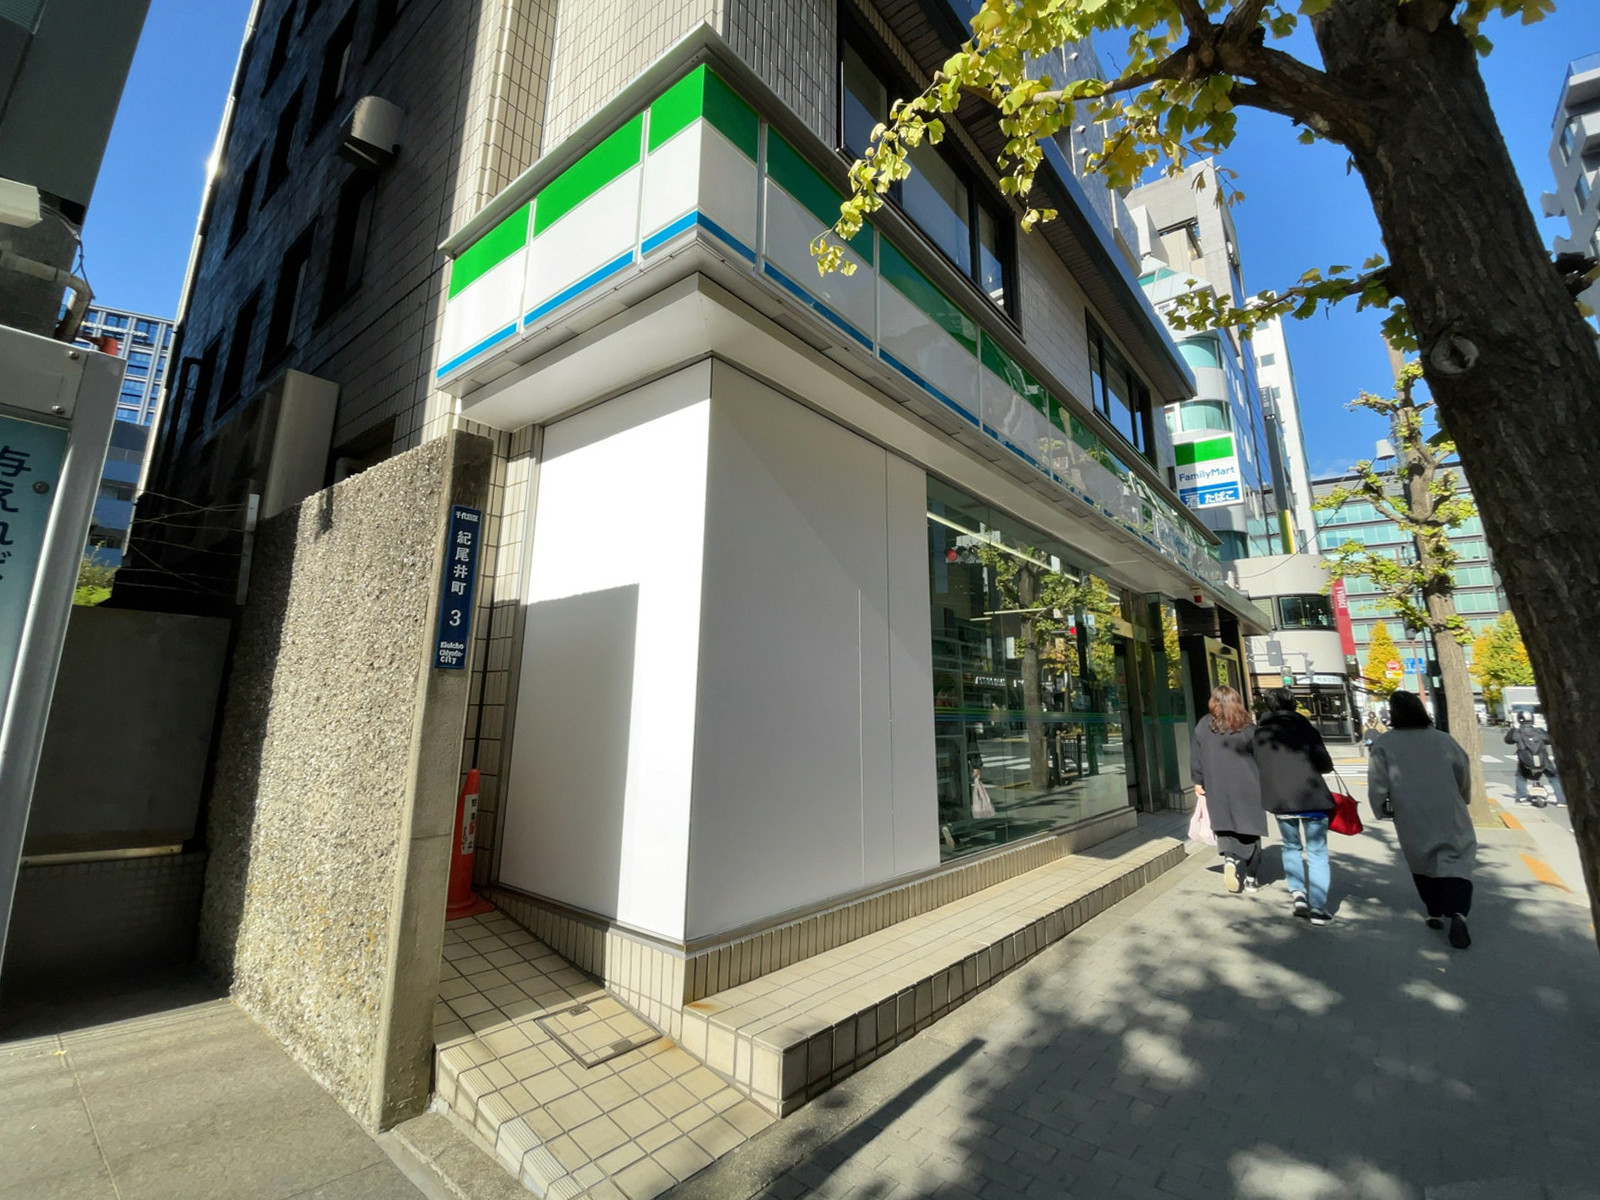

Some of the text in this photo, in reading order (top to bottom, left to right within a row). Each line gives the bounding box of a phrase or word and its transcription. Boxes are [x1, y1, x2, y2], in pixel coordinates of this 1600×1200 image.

[1178, 466, 1235, 482] FamilyMart
[1204, 490, 1236, 504] たばこ
[449, 530, 472, 627] 紀尾井町 3
